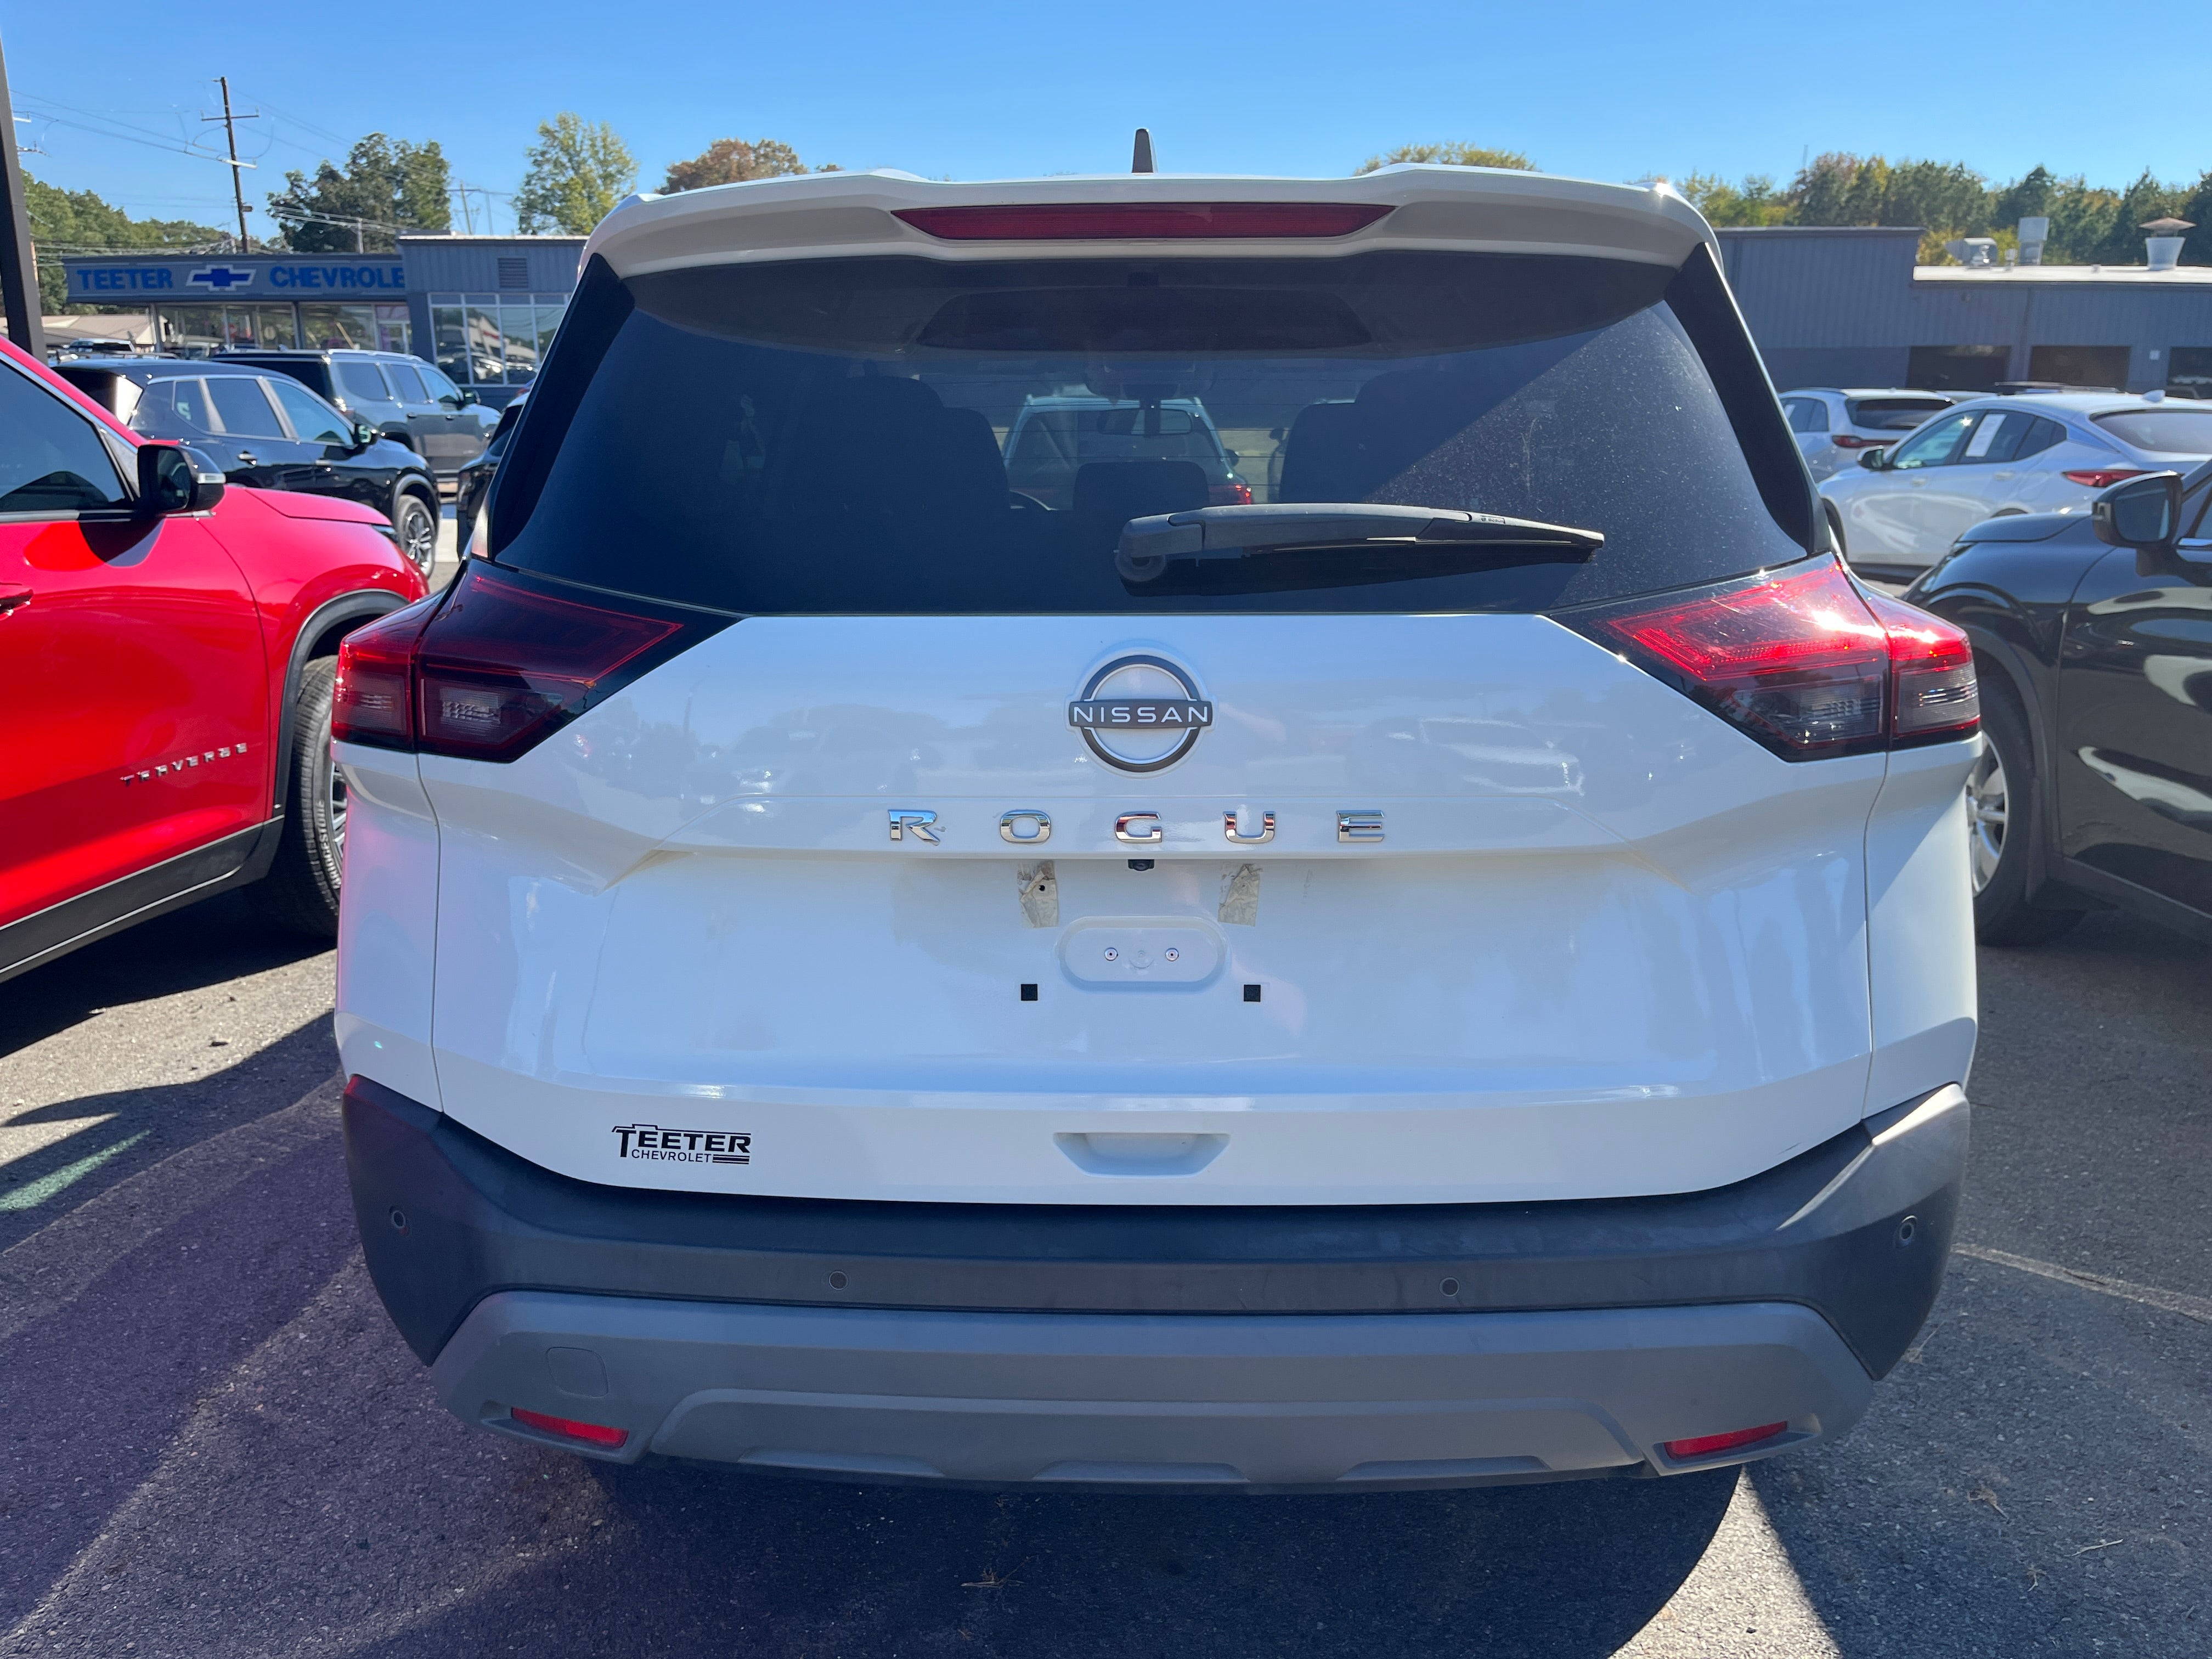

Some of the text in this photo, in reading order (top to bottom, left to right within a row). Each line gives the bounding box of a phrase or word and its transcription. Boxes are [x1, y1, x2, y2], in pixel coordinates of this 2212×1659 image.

[77, 266, 405, 290] TEETER CHEVROLE
[1074, 707, 1207, 723] NISSAN
[120, 742, 247, 786] TRAVERSE
[888, 810, 1385, 843] ROGUE
[616, 1129, 751, 1157] TEETER
[631, 1149, 712, 1163] CHEVROLET
